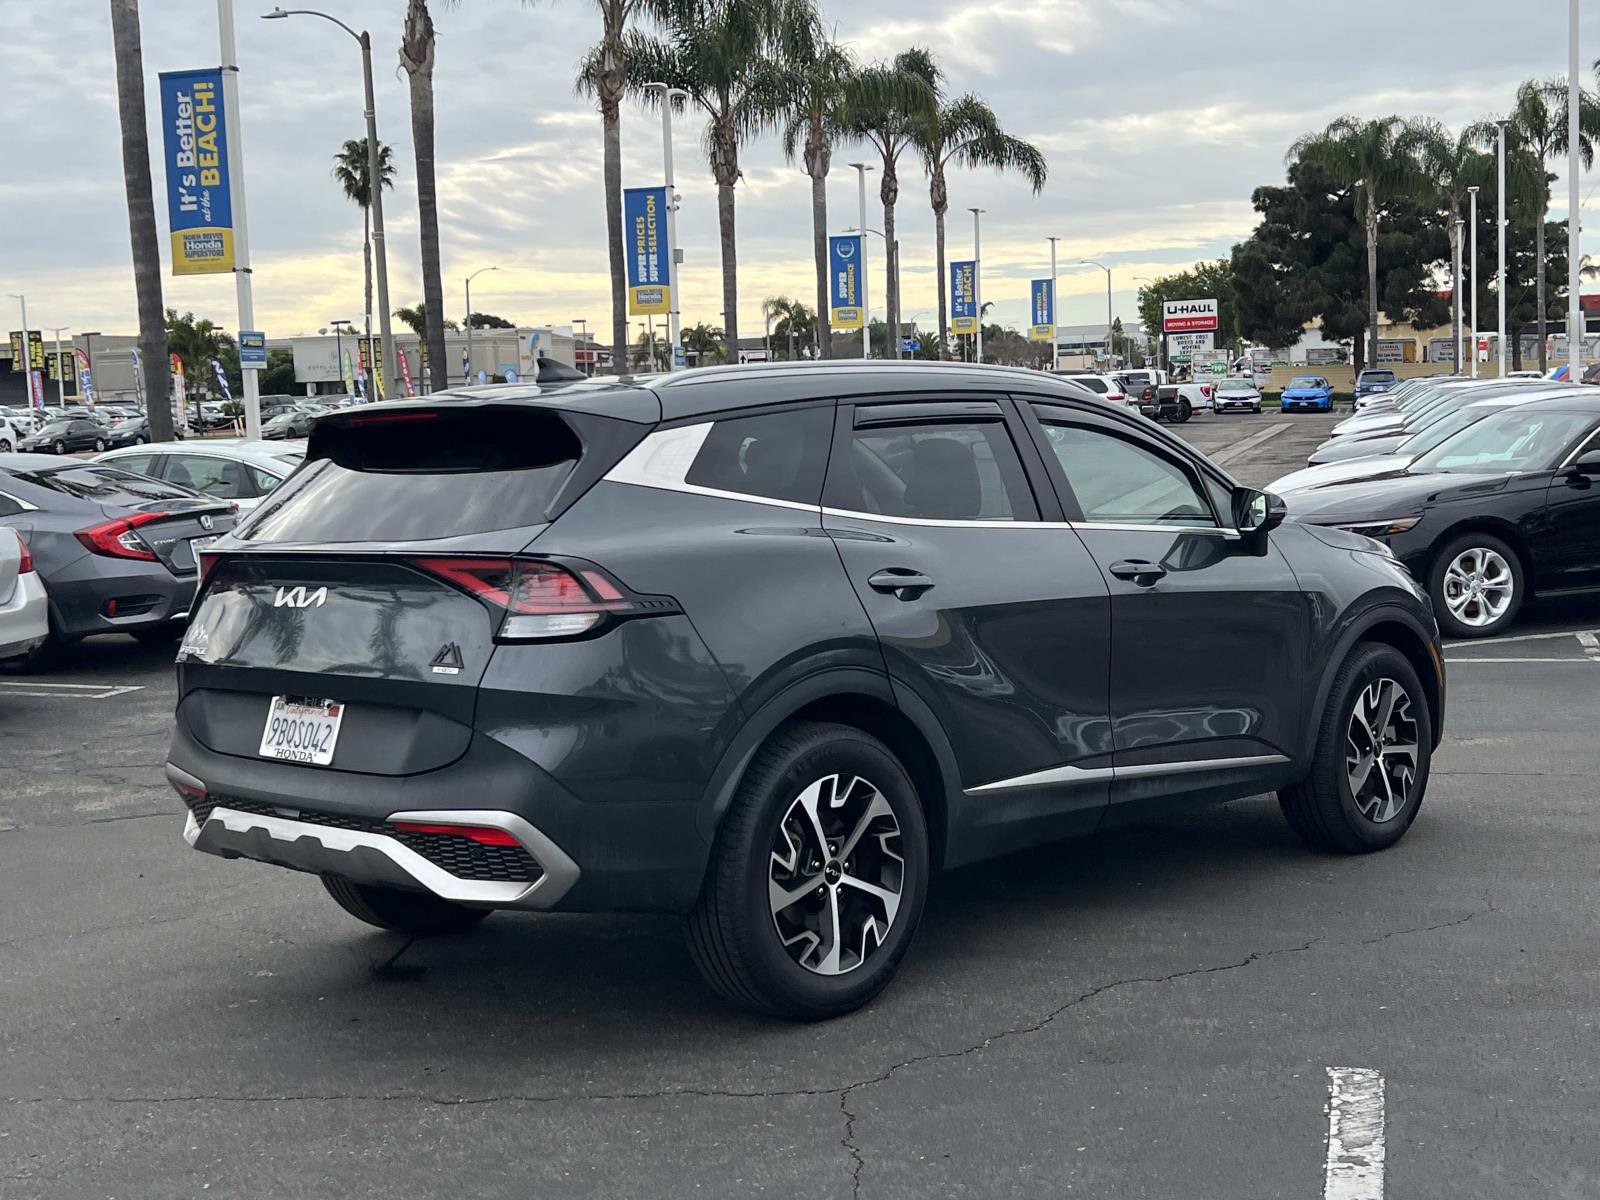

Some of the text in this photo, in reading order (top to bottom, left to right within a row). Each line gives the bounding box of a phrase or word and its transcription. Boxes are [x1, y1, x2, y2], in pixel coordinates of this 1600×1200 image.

[193, 82, 221, 187] BEACH!
[177, 91, 198, 212] It's Better
[201, 189, 212, 222] at the
[184, 250, 225, 258] SUPERSTORE
[186, 240, 222, 250] Honda
[636, 216, 647, 282] SUPER PRICES
[647, 195, 658, 282] SUPER SELECTION
[838, 271, 848, 298] SUPER
[963, 265, 972, 303] BEACH!
[1167, 304, 1214, 314] U-HAUL
[273, 586, 328, 608] KIA
[267, 717, 333, 753] 9BQS042
[275, 748, 314, 763] HONDA
